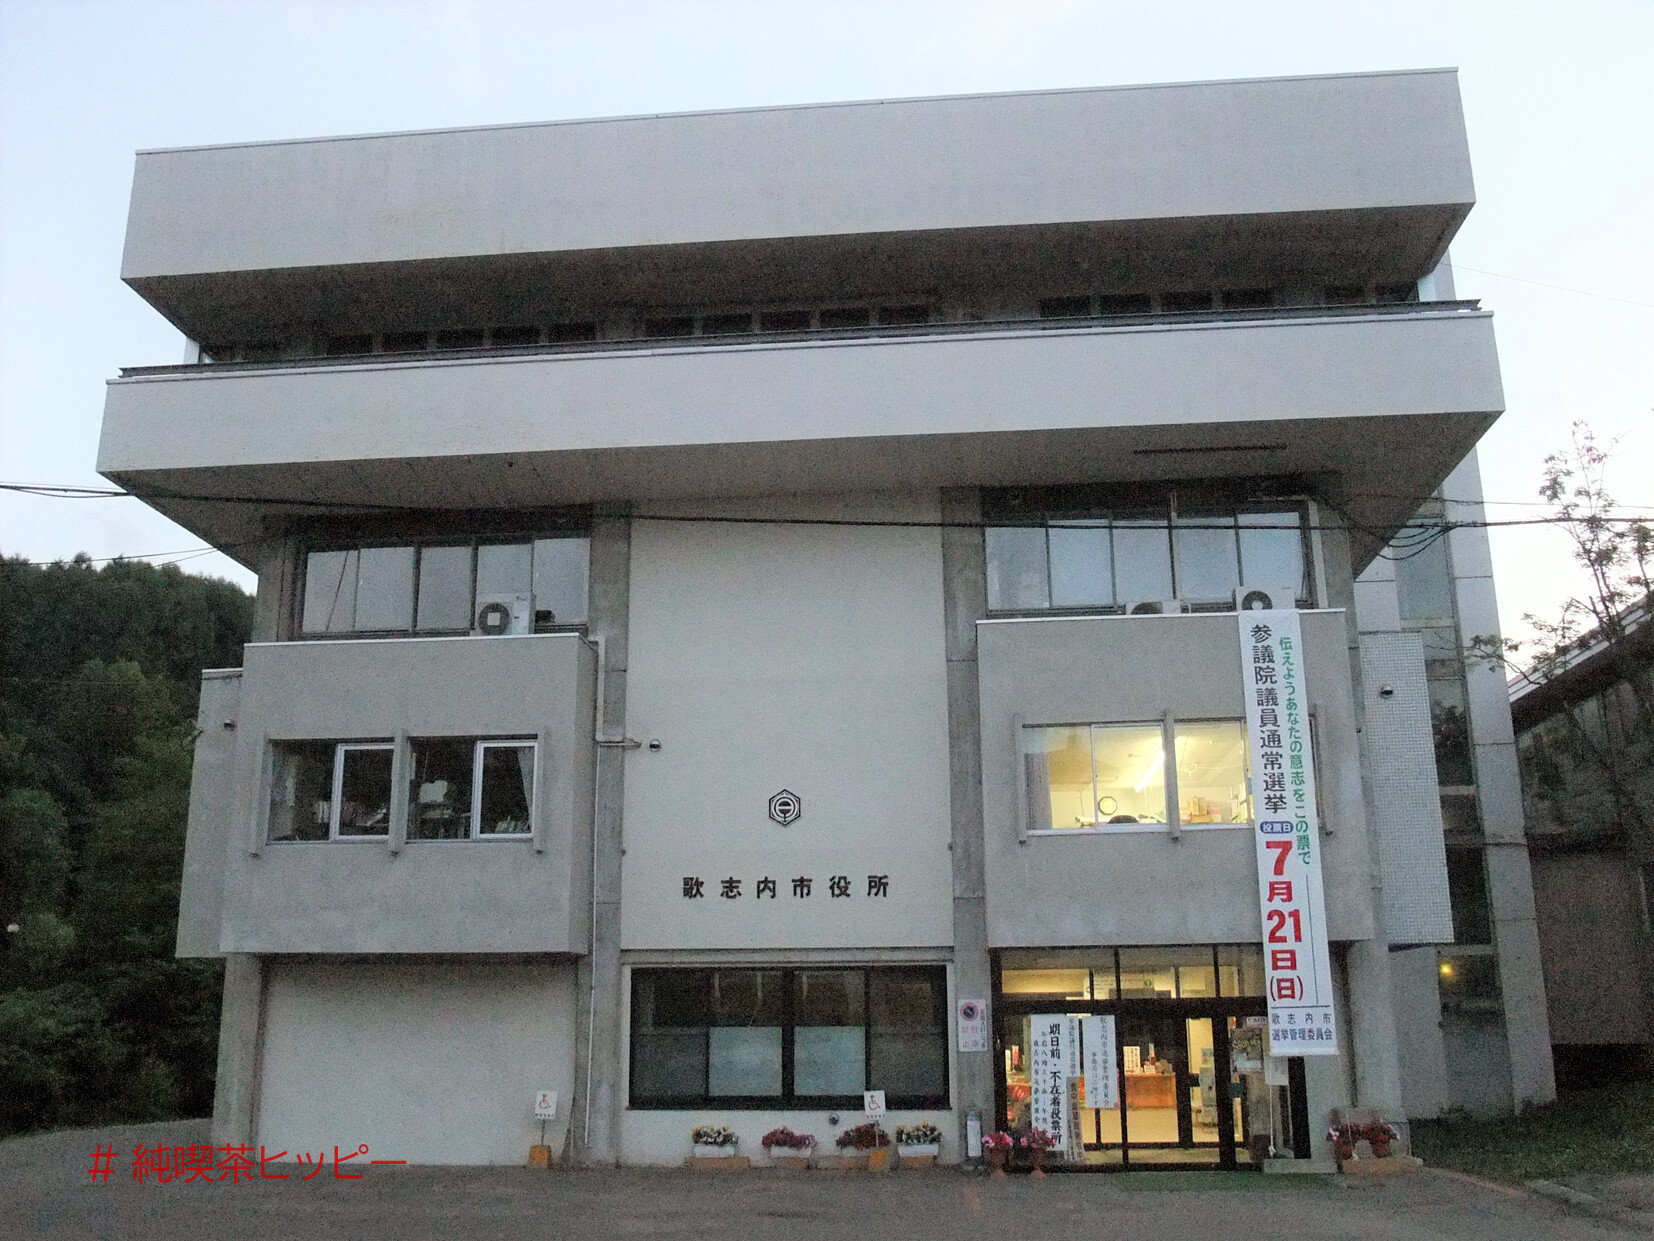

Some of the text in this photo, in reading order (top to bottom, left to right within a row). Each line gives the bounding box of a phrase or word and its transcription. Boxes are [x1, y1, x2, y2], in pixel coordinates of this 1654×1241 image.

[1250, 624, 1287, 814] 参議院議員通常選挙
[1262, 823, 1292, 834] 投票日
[682, 875, 890, 899] 歌志内市役所
[1271, 1013, 1332, 1025] 歌志内市
[1271, 1028, 1333, 1042] 選挙管理委員会
